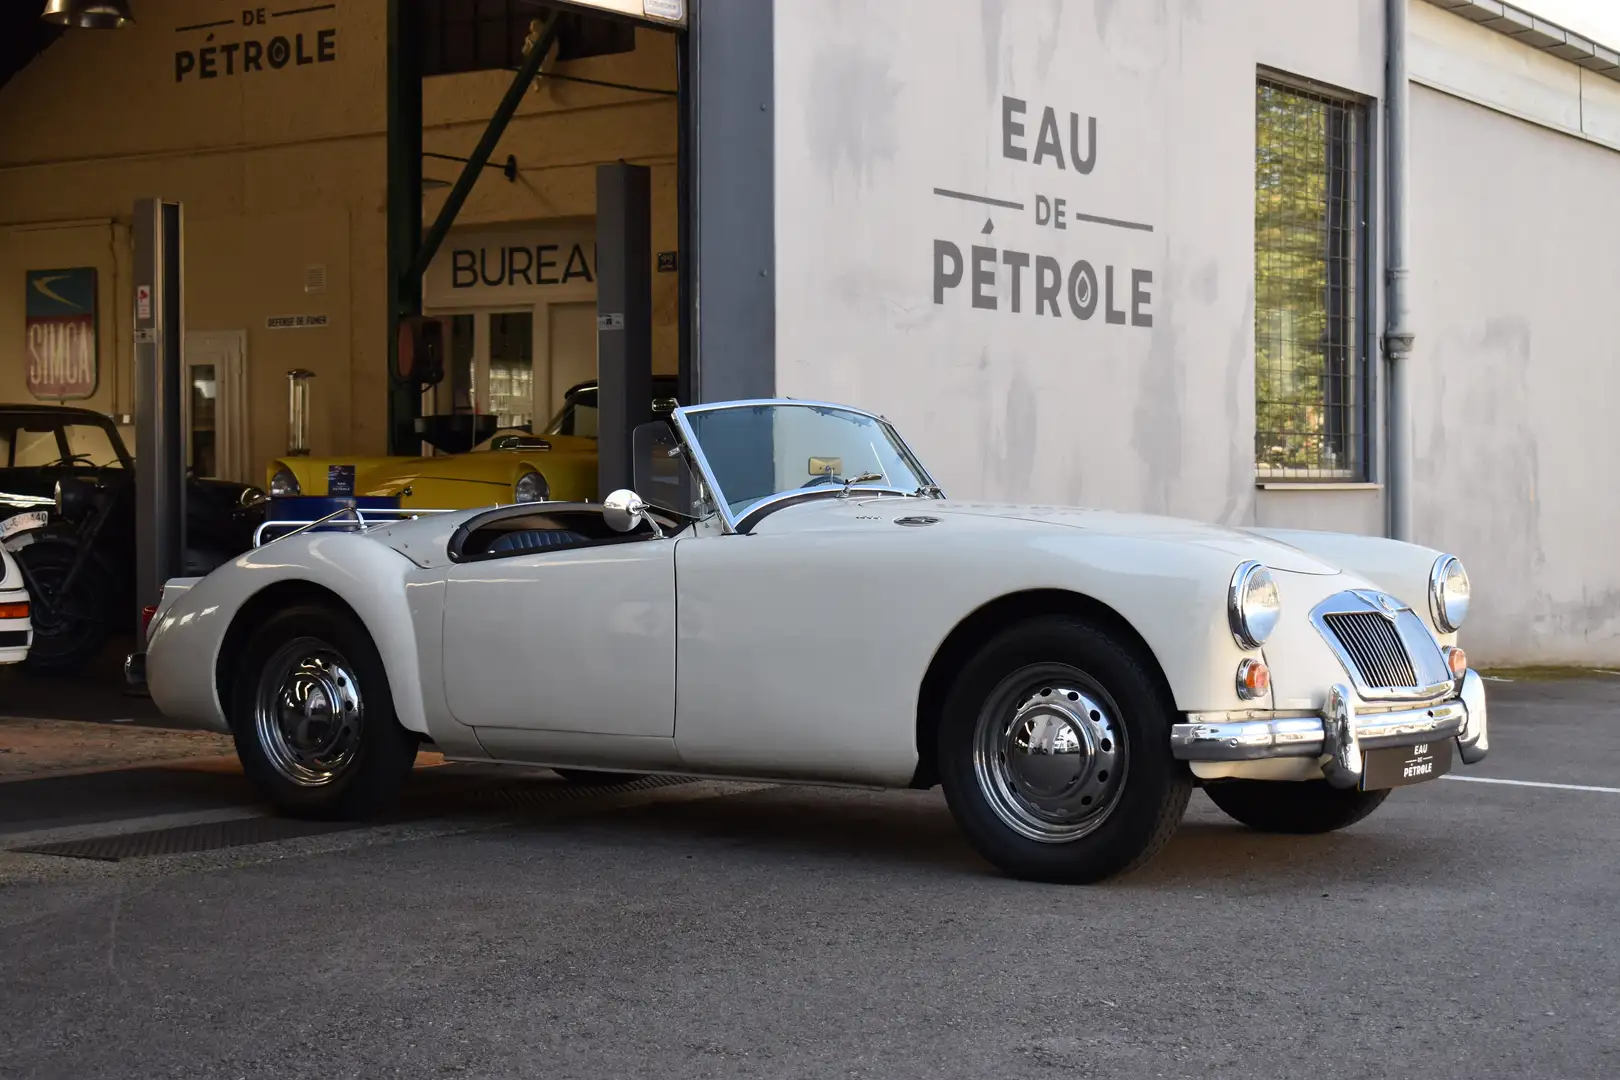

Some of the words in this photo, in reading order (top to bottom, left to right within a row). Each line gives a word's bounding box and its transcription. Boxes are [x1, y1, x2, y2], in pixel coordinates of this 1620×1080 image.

[242, 8, 266, 26] DE
[175, 29, 336, 82] PÉTROLE
[1002, 95, 1097, 175] EAU
[1035, 194, 1067, 230] DE
[452, 242, 598, 288] BUREA
[933, 217, 1153, 328] PÉTROLE
[29, 322, 91, 385] SIMCA
[1403, 763, 1432, 778] PÉTROLE
[1414, 744, 1428, 755] EAU
